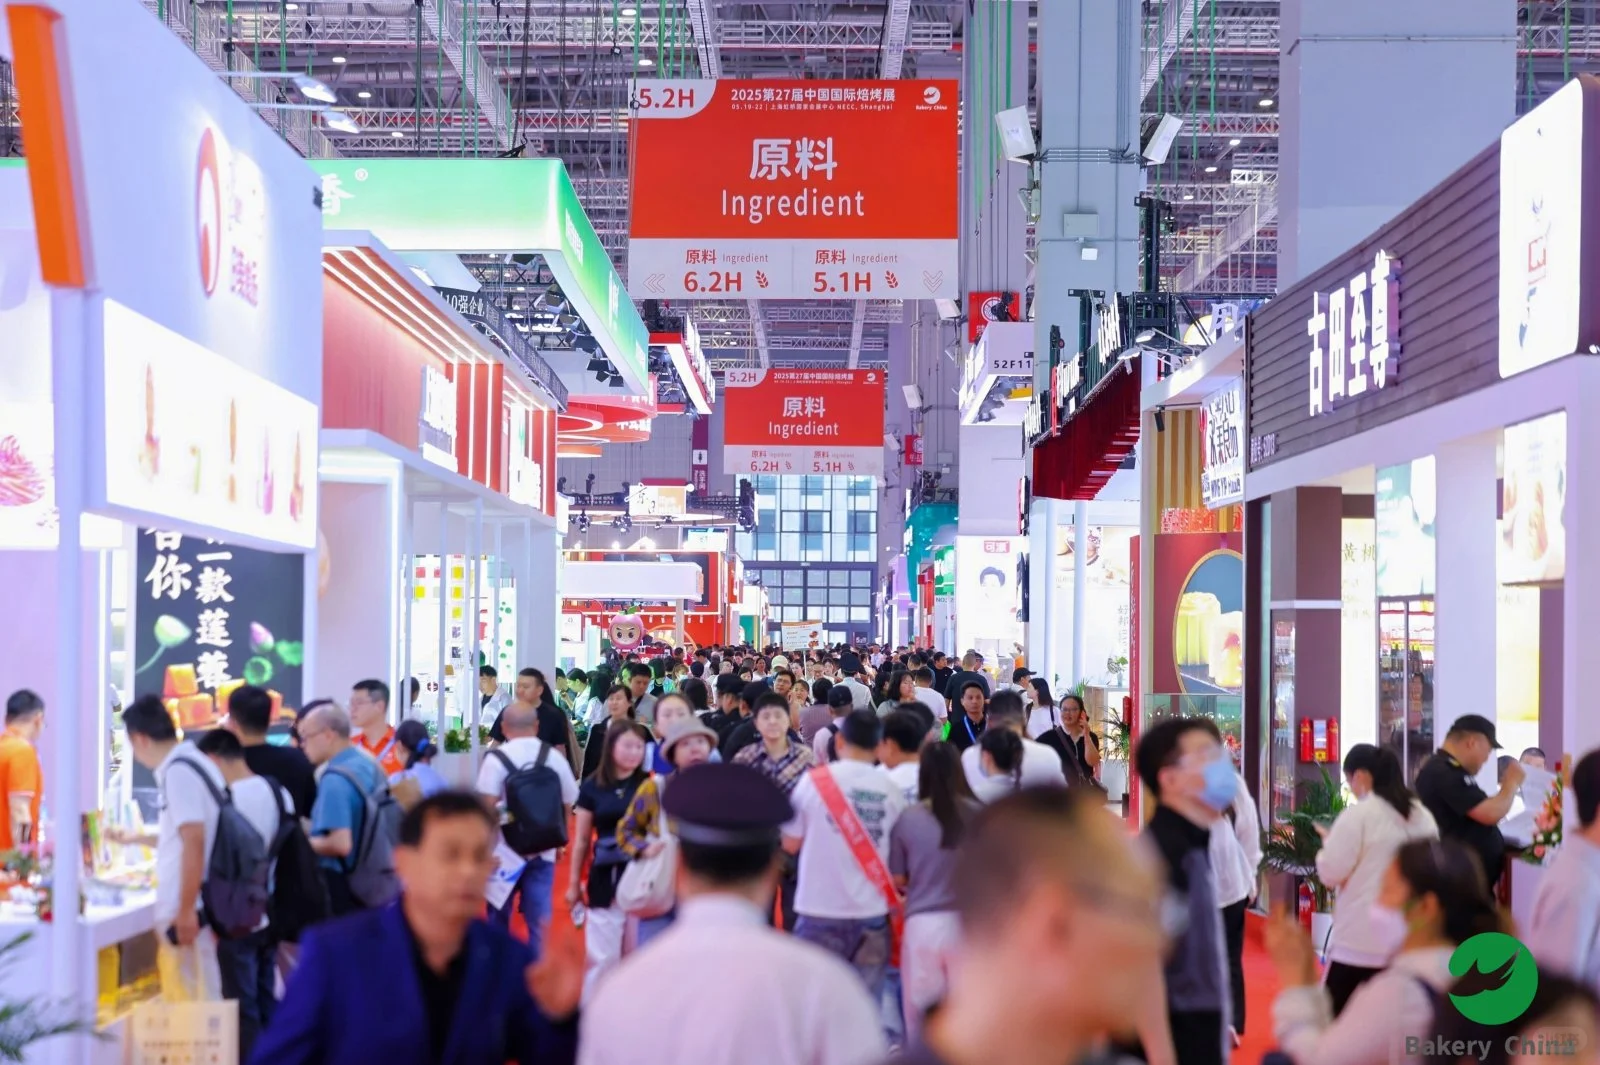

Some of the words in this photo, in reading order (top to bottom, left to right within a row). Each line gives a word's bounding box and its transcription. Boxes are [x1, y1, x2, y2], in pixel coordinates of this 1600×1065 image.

[639, 87, 695, 109] 5.2H
[731, 87, 896, 102] 2025第27届中国国际焙烤展
[860, 103, 893, 112] Shanghai
[749, 136, 838, 181] 原料
[722, 188, 865, 224] Ingredient
[685, 248, 716, 265] 原料
[722, 252, 769, 264] Ingredient
[815, 248, 847, 265] 原料
[852, 252, 898, 264] Ingredient
[684, 271, 742, 293] 6.2H
[814, 271, 871, 293] 5.1H
[1307, 249, 1390, 417] 古田至尊
[993, 360, 1031, 369] 52F11
[729, 372, 757, 382] 5.2H
[782, 396, 826, 418] 原料
[768, 421, 839, 439] Ingredient
[751, 450, 767, 458] 原料
[813, 450, 829, 459] 原料
[750, 461, 779, 472] 6.2H
[813, 462, 842, 472] 5.1H
